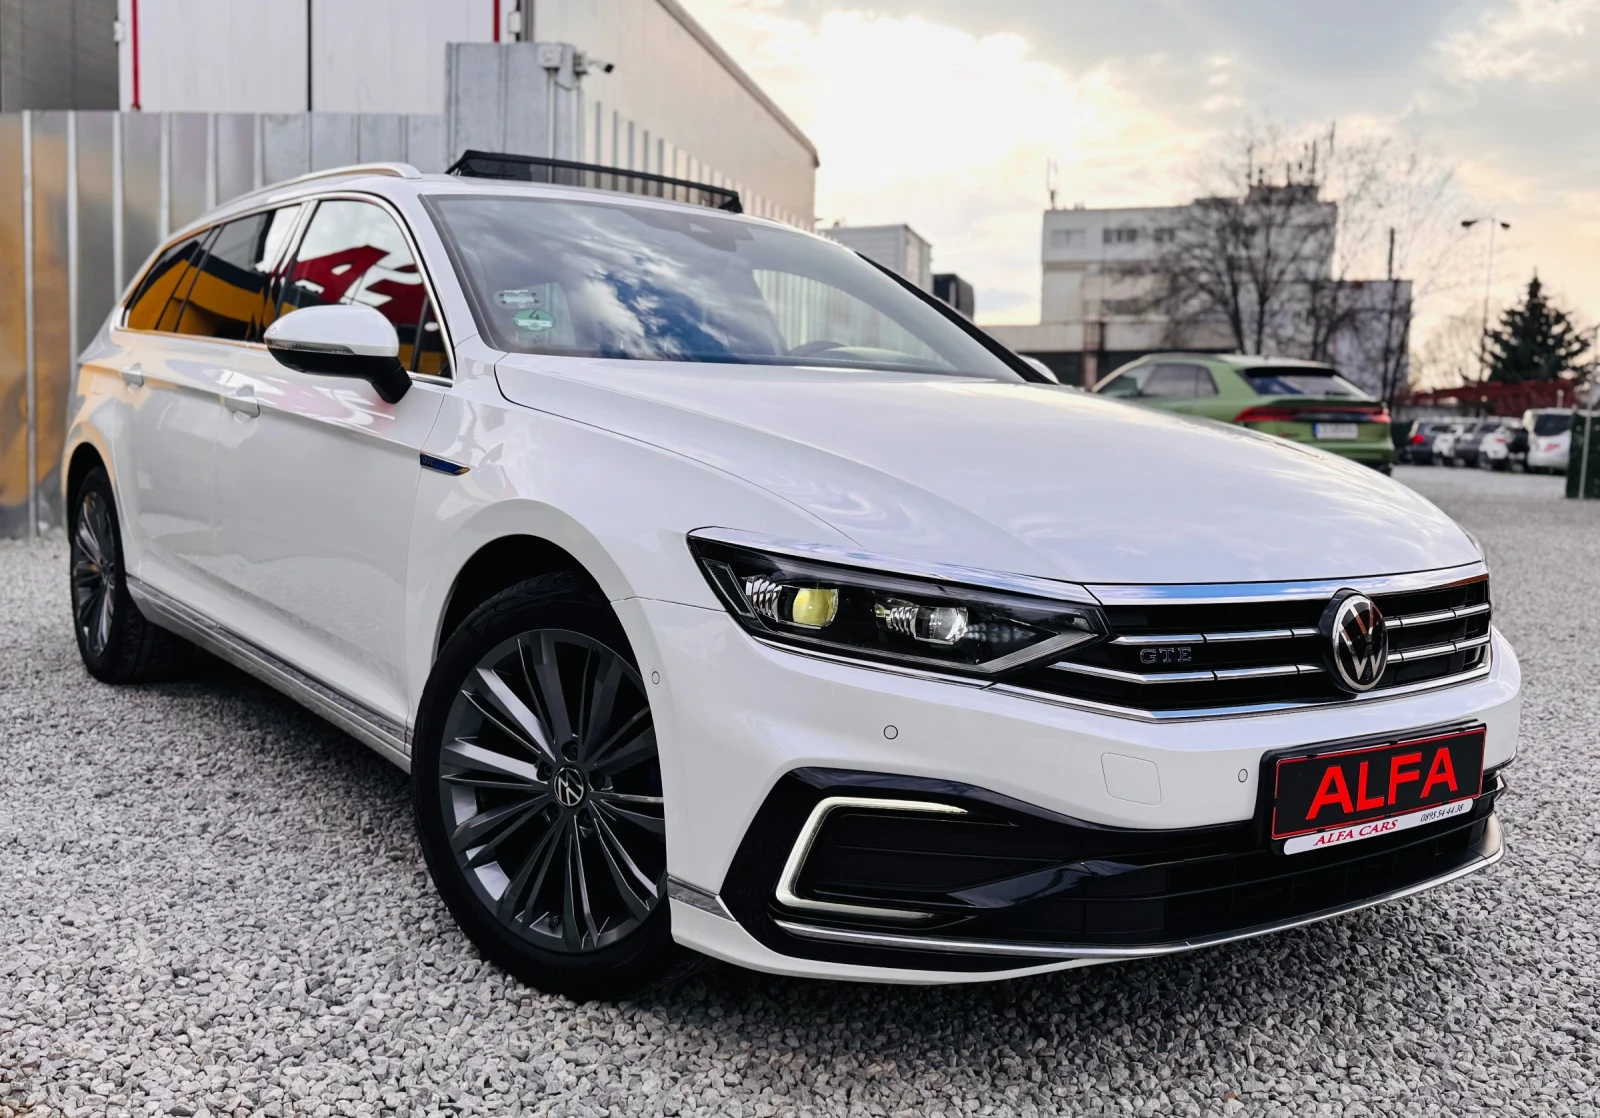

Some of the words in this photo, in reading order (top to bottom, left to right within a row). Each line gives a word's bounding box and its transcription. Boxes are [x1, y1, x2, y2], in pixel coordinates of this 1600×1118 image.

[528, 310, 540, 320] 4
[1140, 646, 1192, 664] GTE
[1305, 746, 1458, 821] ALFA
[1420, 810, 1437, 823] 0895
[1437, 809, 1446, 819] 54
[1446, 806, 1456, 815] 44
[1313, 828, 1355, 847] ALFA
[1358, 819, 1399, 837] CARS
